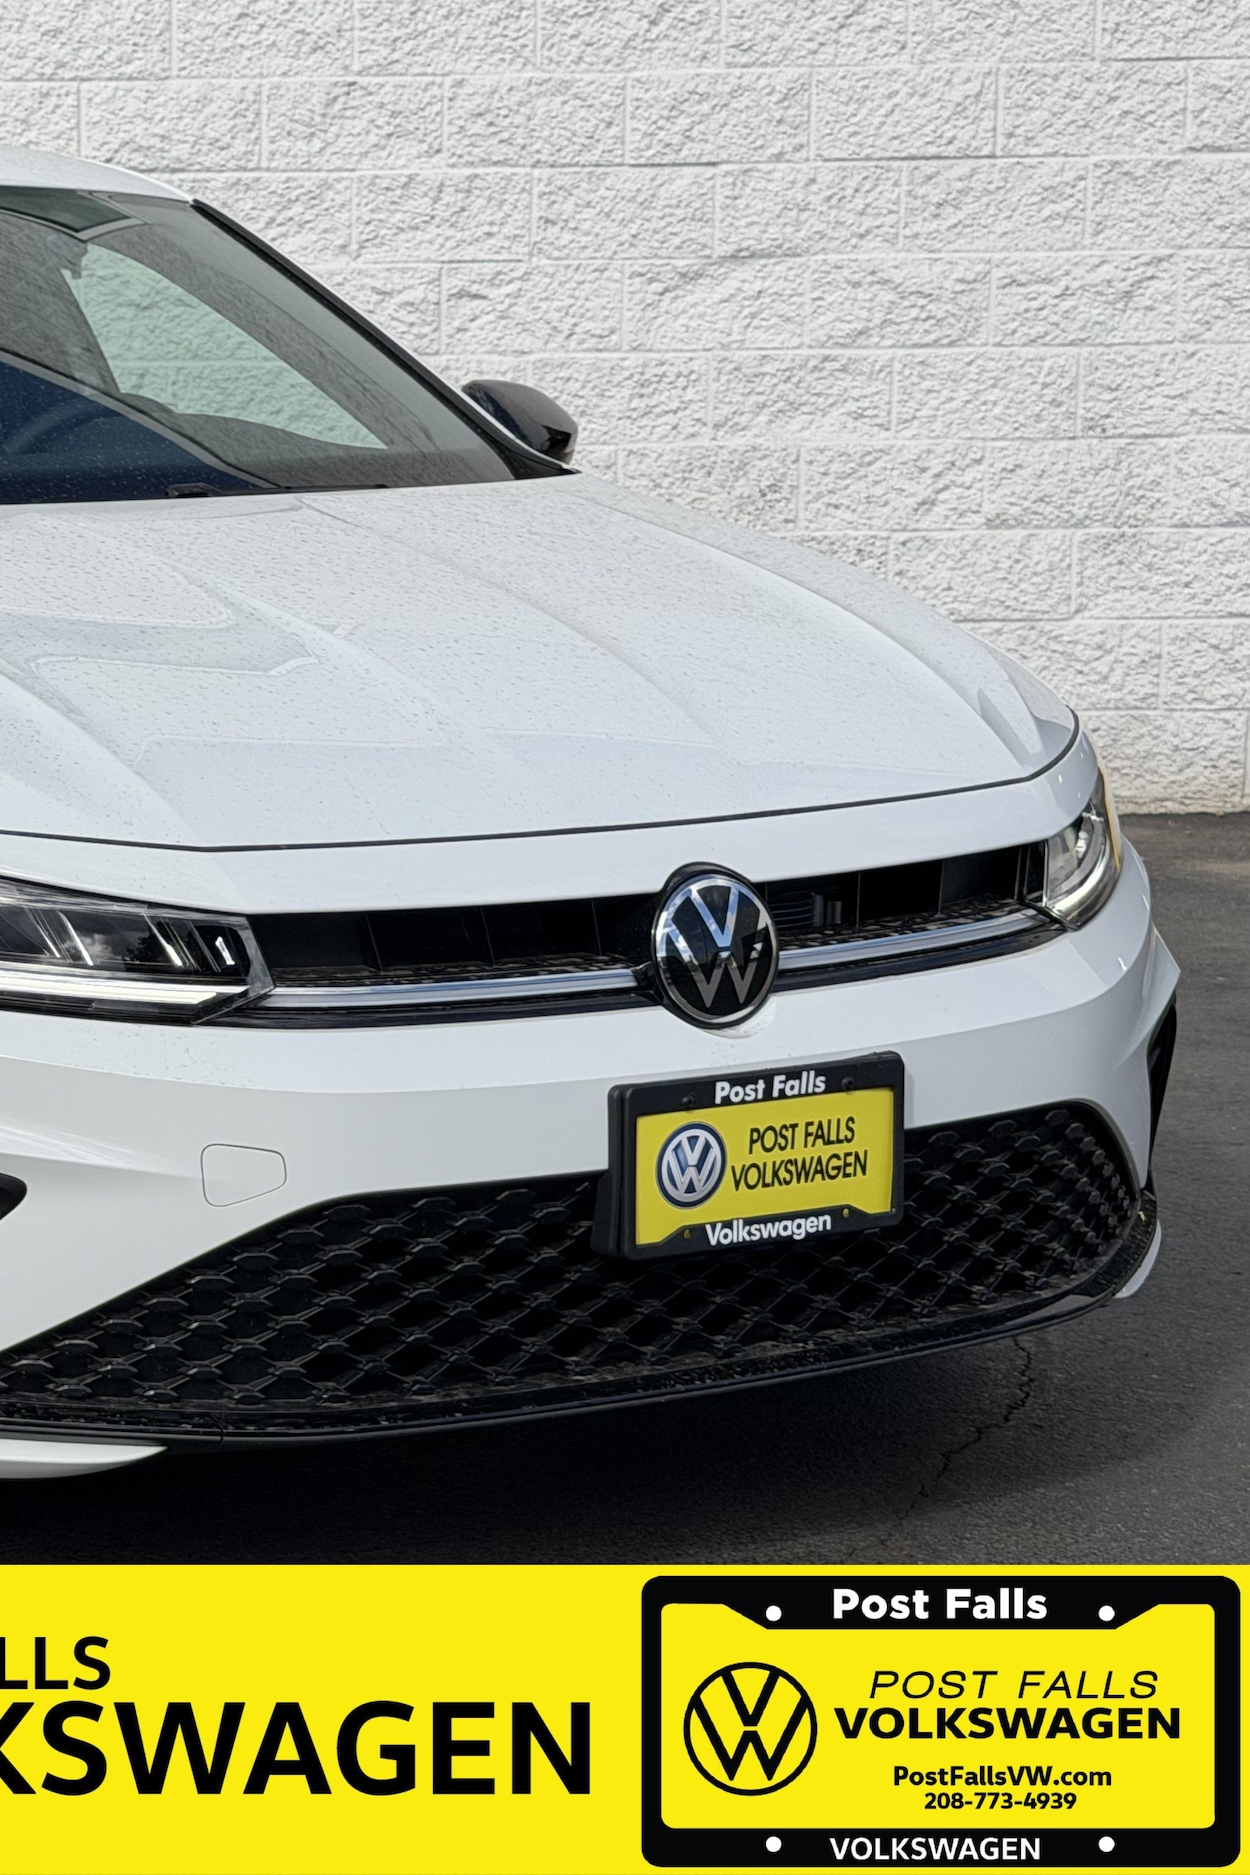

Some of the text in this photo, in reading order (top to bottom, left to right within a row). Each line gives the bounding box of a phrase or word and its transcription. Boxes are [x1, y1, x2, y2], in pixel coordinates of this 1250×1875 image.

[714, 1070, 827, 1105] Post Falls
[748, 1116, 856, 1154] POST FALLS
[730, 1149, 868, 1192] VOLKSWAGEN
[705, 1214, 832, 1246] Volkswagen
